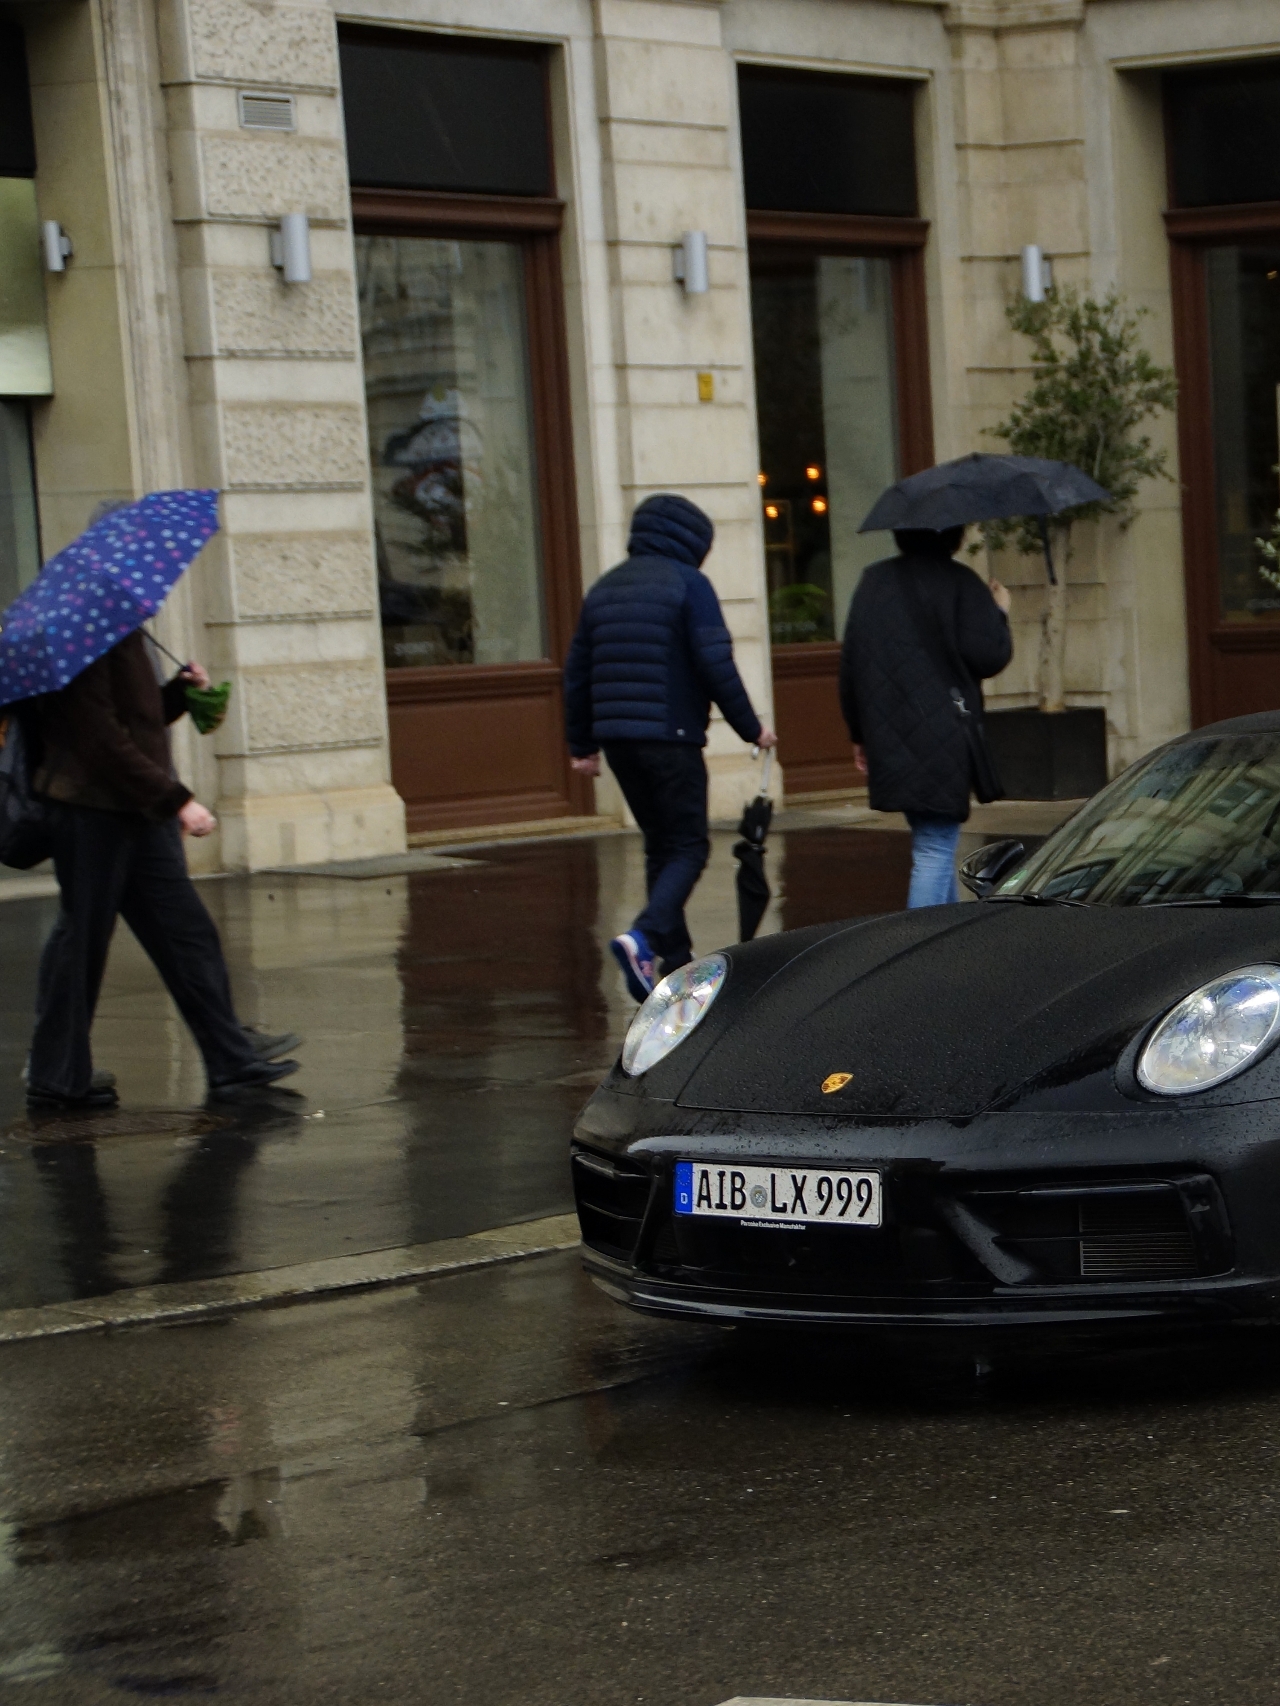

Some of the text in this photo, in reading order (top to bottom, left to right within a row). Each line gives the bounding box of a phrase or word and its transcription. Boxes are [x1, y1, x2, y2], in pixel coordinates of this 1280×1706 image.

[696, 1169, 873, 1218] AIB LX 999
